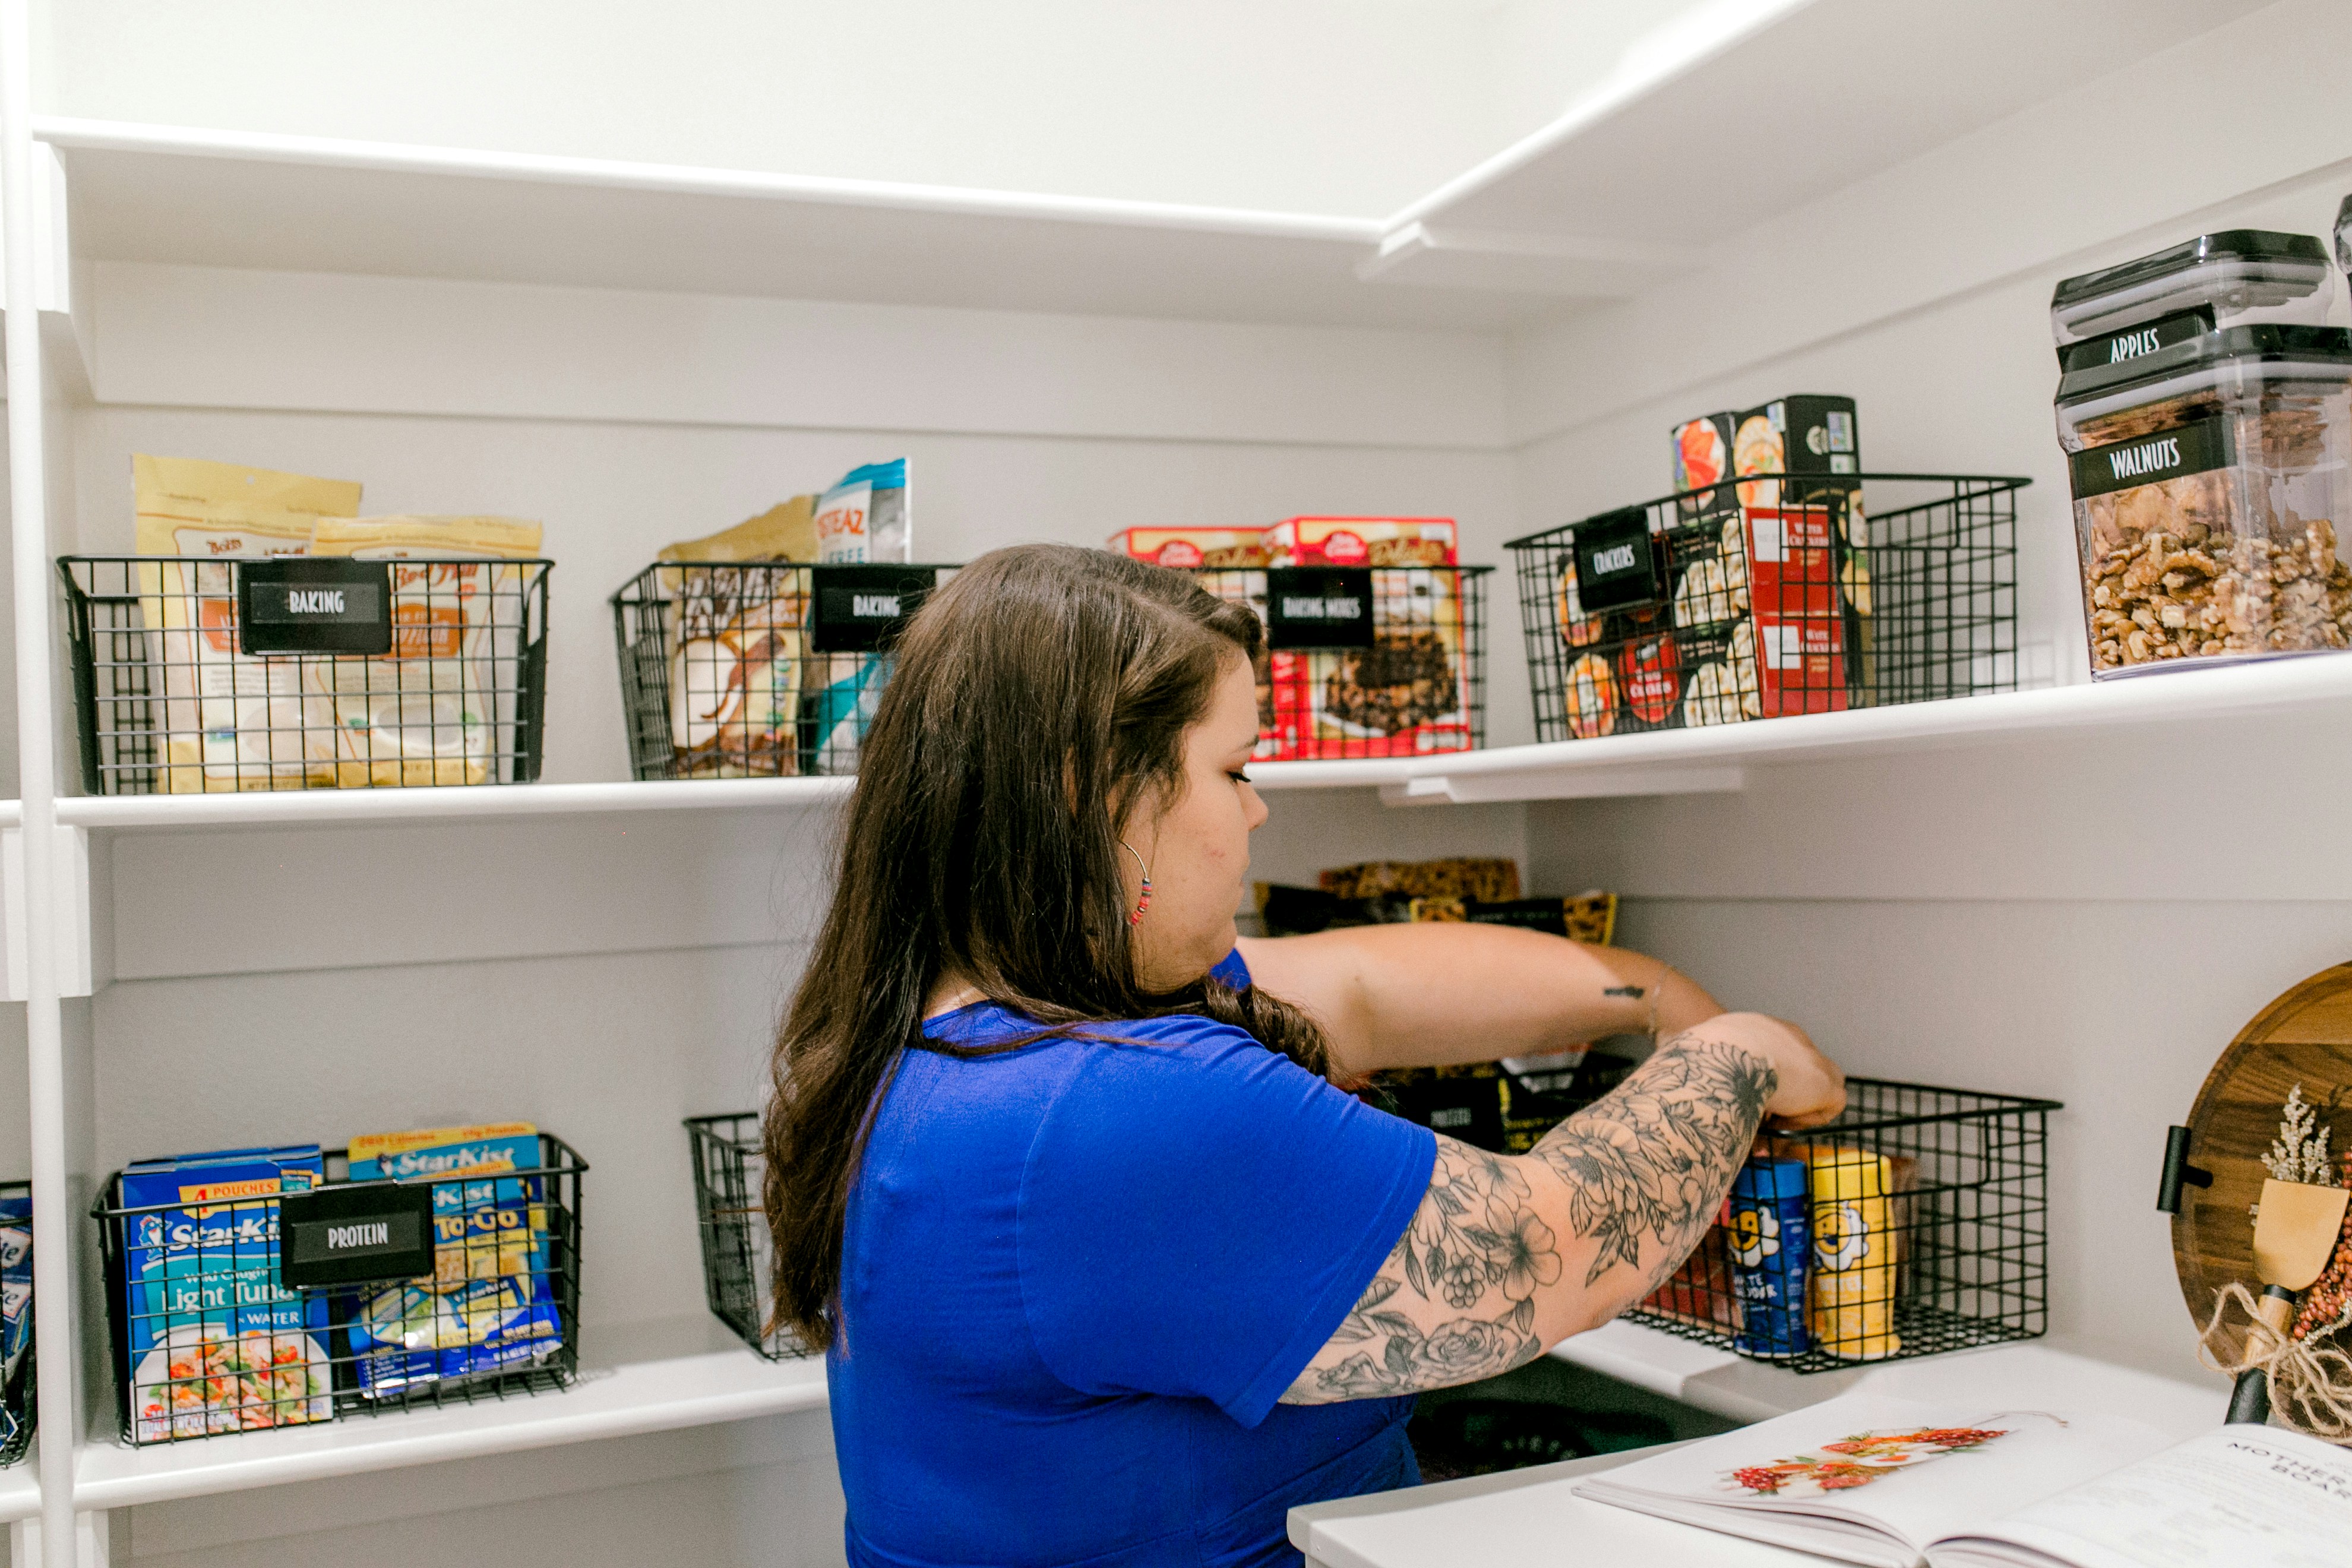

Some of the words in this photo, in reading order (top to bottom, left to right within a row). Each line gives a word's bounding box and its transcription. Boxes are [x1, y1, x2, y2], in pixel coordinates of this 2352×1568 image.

[2110, 328, 2160, 363] APPLES
[2110, 438, 2180, 480] WALNUTS
[289, 590, 344, 614] BAKING
[853, 595, 900, 617] BAKING
[399, 1145, 515, 1175] StarKist
[194, 1188, 208, 1213] 4
[213, 1183, 275, 1197] POUCHES
[435, 1183, 494, 1208] Kist
[169, 1215, 281, 1251] StarKi
[328, 1222, 388, 1250] PROTEIN
[434, 1206, 519, 1240] To-Go
[161, 1286, 226, 1316] Light
[229, 1281, 295, 1305] Tuna
[246, 1310, 300, 1326] WATER
